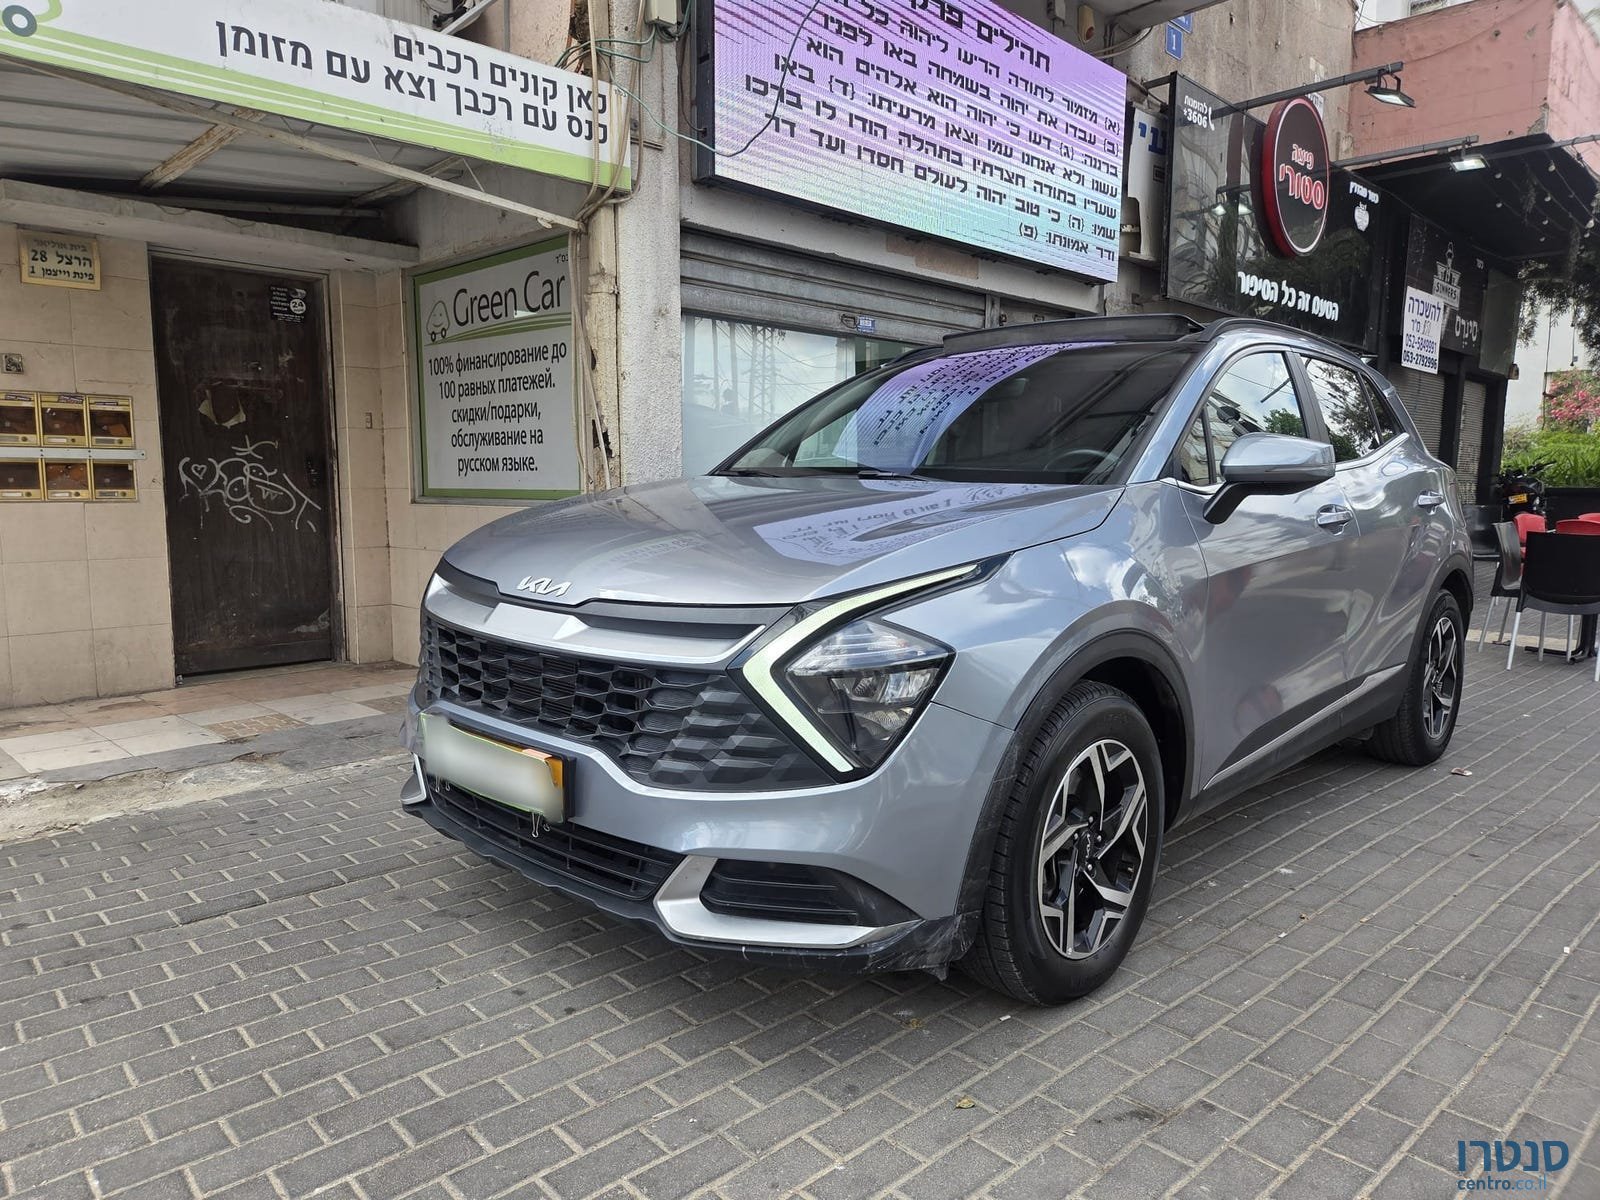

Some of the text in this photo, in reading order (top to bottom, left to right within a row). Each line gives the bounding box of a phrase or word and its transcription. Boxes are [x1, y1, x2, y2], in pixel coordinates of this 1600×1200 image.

[861, 0, 889, 26] כל
[823, 13, 873, 47] לפניו
[900, 20, 949, 53] ליהוה
[1172, 33, 1177, 51] 1
[806, 36, 843, 66] הוא
[884, 40, 918, 68] באו
[977, 20, 1050, 73] תהילים
[393, 34, 607, 114] כאן קונים רכבים
[775, 53, 815, 84] באו
[958, 47, 1000, 78] הריעו
[215, 20, 608, 144] כנס עם רכבך וצא עם מזומן
[856, 57, 917, 95] אלהים
[928, 60, 991, 101] בשמחה
[1009, 72, 1055, 102] לתודה
[867, 92, 936, 130] מרעיתו:
[928, 88, 957, 112] הוא
[1000, 92, 1029, 115] יהוה
[1062, 97, 1098, 125] מזמור
[1184, 95, 1208, 114] להזמנות
[764, 113, 797, 138] דר
[967, 104, 998, 127] יהוה
[1036, 110, 1058, 130] את
[809, 128, 845, 154] ועד
[945, 122, 979, 146] וצאן
[1006, 121, 1020, 137] כי
[1029, 130, 1052, 150] דעו
[1065, 122, 1097, 146] עבדו
[746, 74, 1117, 220] שעריו בתודה חצרתיו בתהלה הודו לו ברכו
[857, 145, 904, 173] חסדו
[987, 139, 1014, 158] עמו
[1291, 143, 1315, 170] פיצה
[1021, 150, 1056, 175] אנחנו
[914, 165, 968, 193] לעולם
[1063, 167, 1085, 186] ולא
[1091, 178, 1118, 198] עשנו
[1279, 163, 1325, 210] סטורי
[976, 185, 1007, 206] יהוה
[1015, 197, 1040, 217] טוב
[1048, 208, 1061, 223] כי
[31, 249, 92, 268] הרצל 28
[1096, 246, 1115, 261] ודר
[41, 267, 71, 278] וייצמן
[73, 271, 95, 280] פינת
[453, 270, 566, 327] Green Car
[1237, 271, 1340, 322] הטעם זה כל הסיפור
[1435, 281, 1457, 300] SINNERS
[1407, 296, 1442, 322] להשכרה
[429, 341, 567, 377] 100% финансирование до
[439, 367, 556, 402] 100 равных платежей.
[451, 401, 541, 426] скидки/подарки,
[451, 428, 544, 452] обслуживание на
[457, 456, 538, 477] русском языке.
[516, 575, 572, 597] KIA
